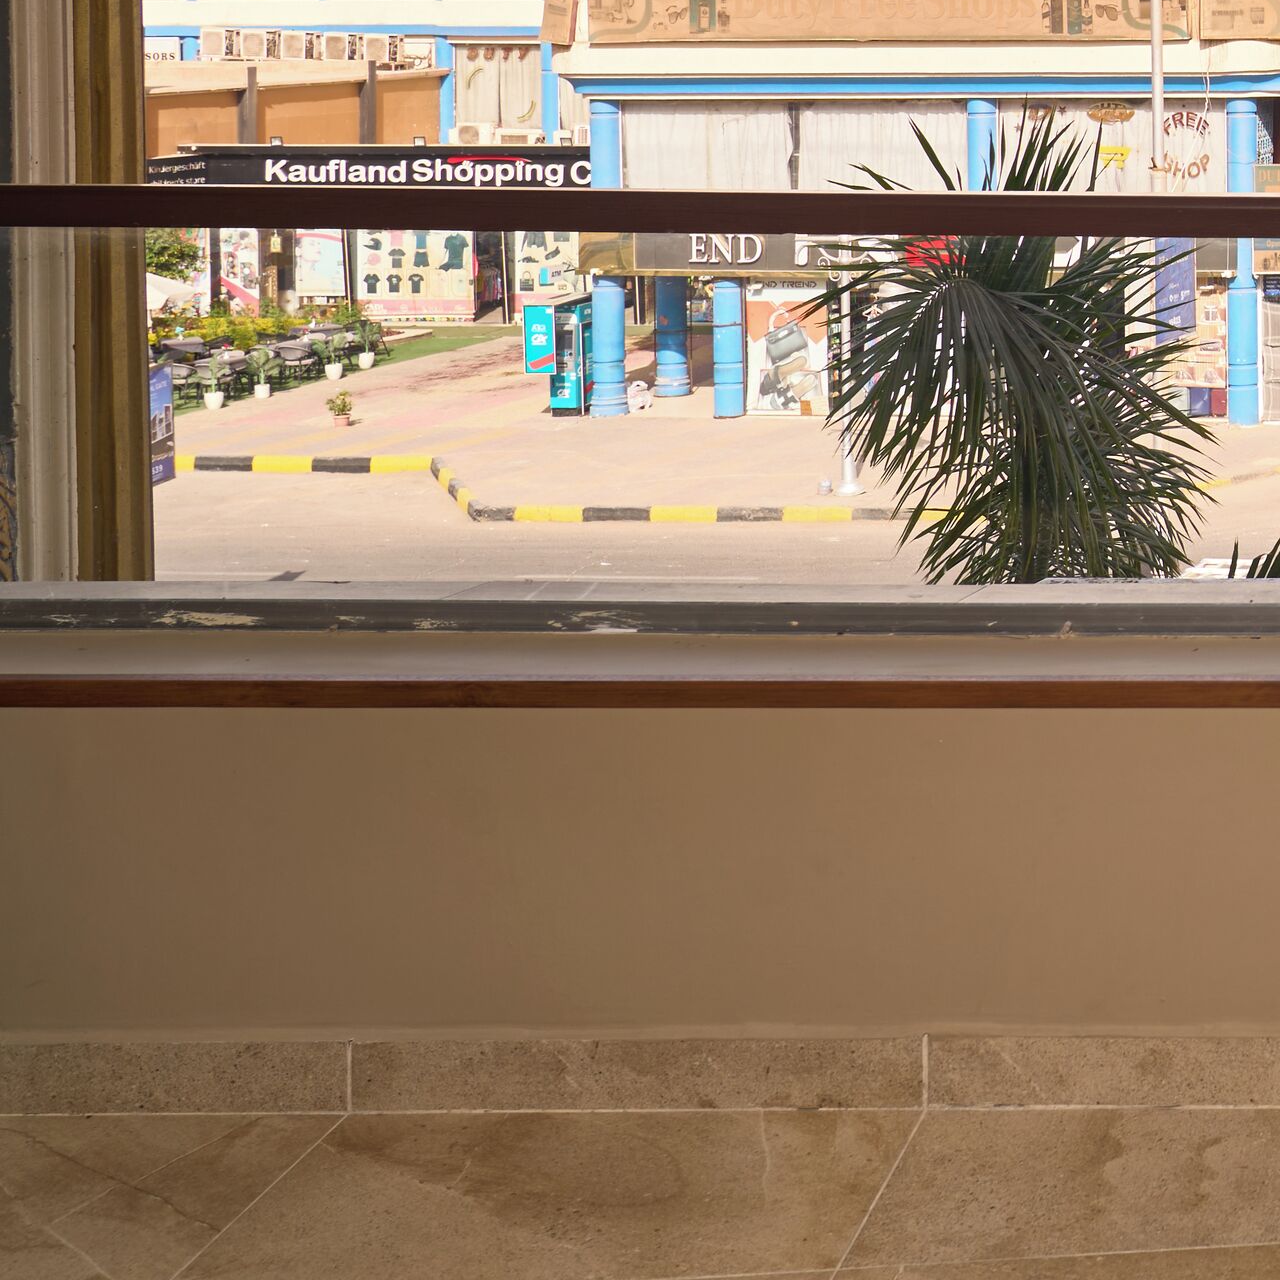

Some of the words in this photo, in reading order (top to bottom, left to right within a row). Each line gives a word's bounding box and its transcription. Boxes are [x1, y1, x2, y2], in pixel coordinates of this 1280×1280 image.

[1163, 111, 1210, 136] FREE
[264, 159, 407, 183] Kaufland
[688, 233, 763, 264] END
